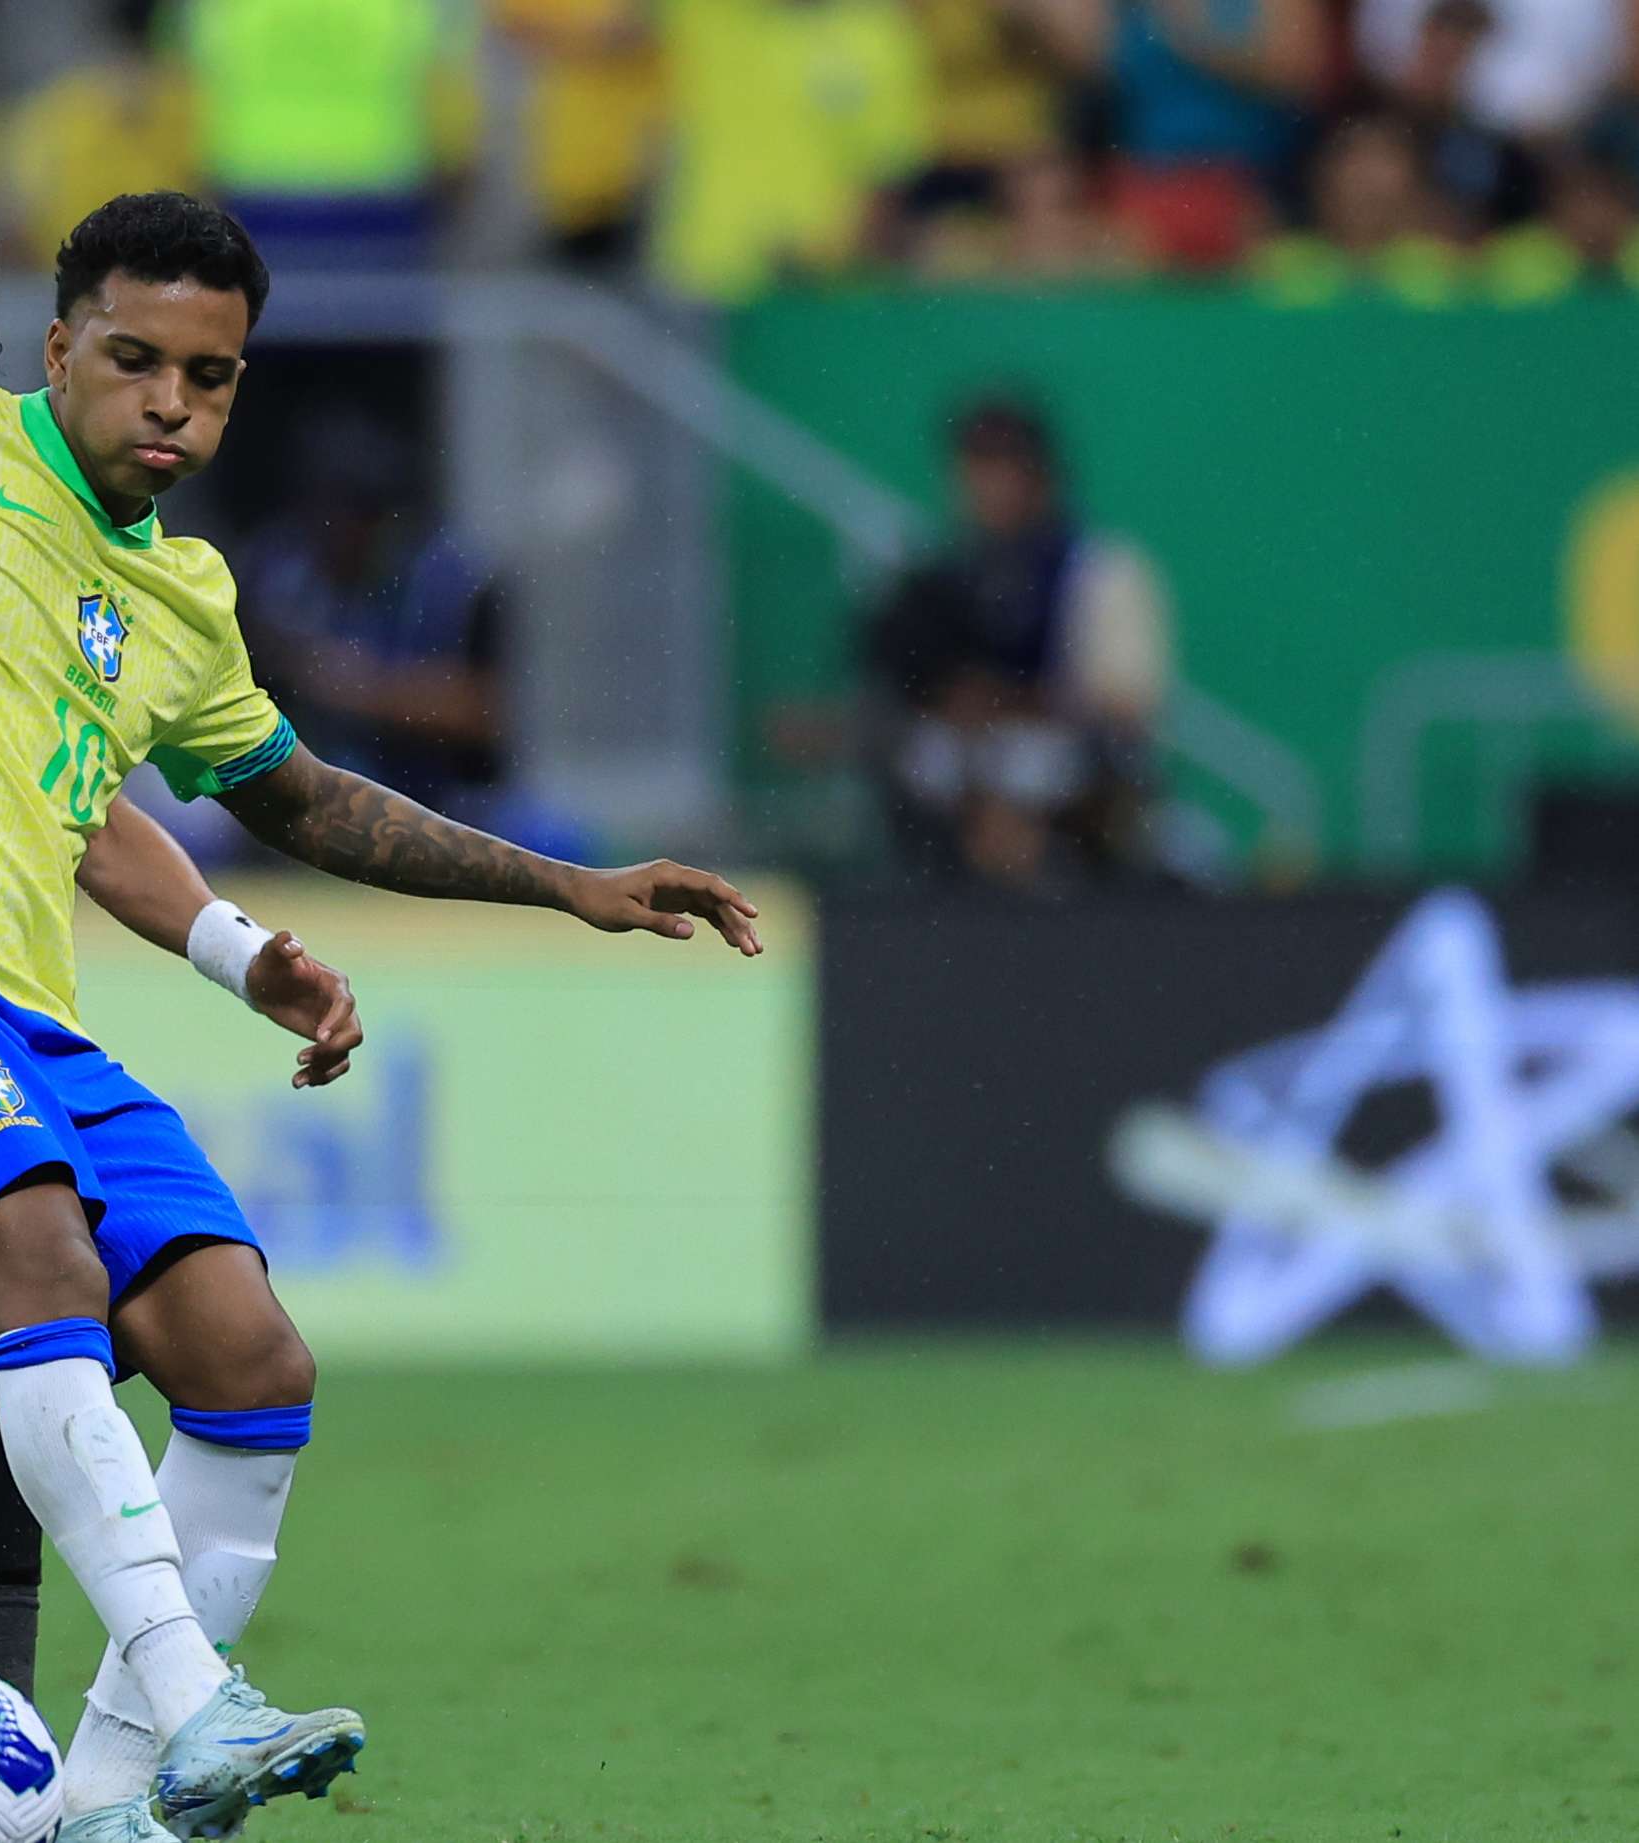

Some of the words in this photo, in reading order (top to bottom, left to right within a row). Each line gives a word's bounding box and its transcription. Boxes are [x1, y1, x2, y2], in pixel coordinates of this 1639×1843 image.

[90, 627, 110, 646] CBF
[64, 664, 116, 719] BRASIL
[39, 696, 106, 823] 10
